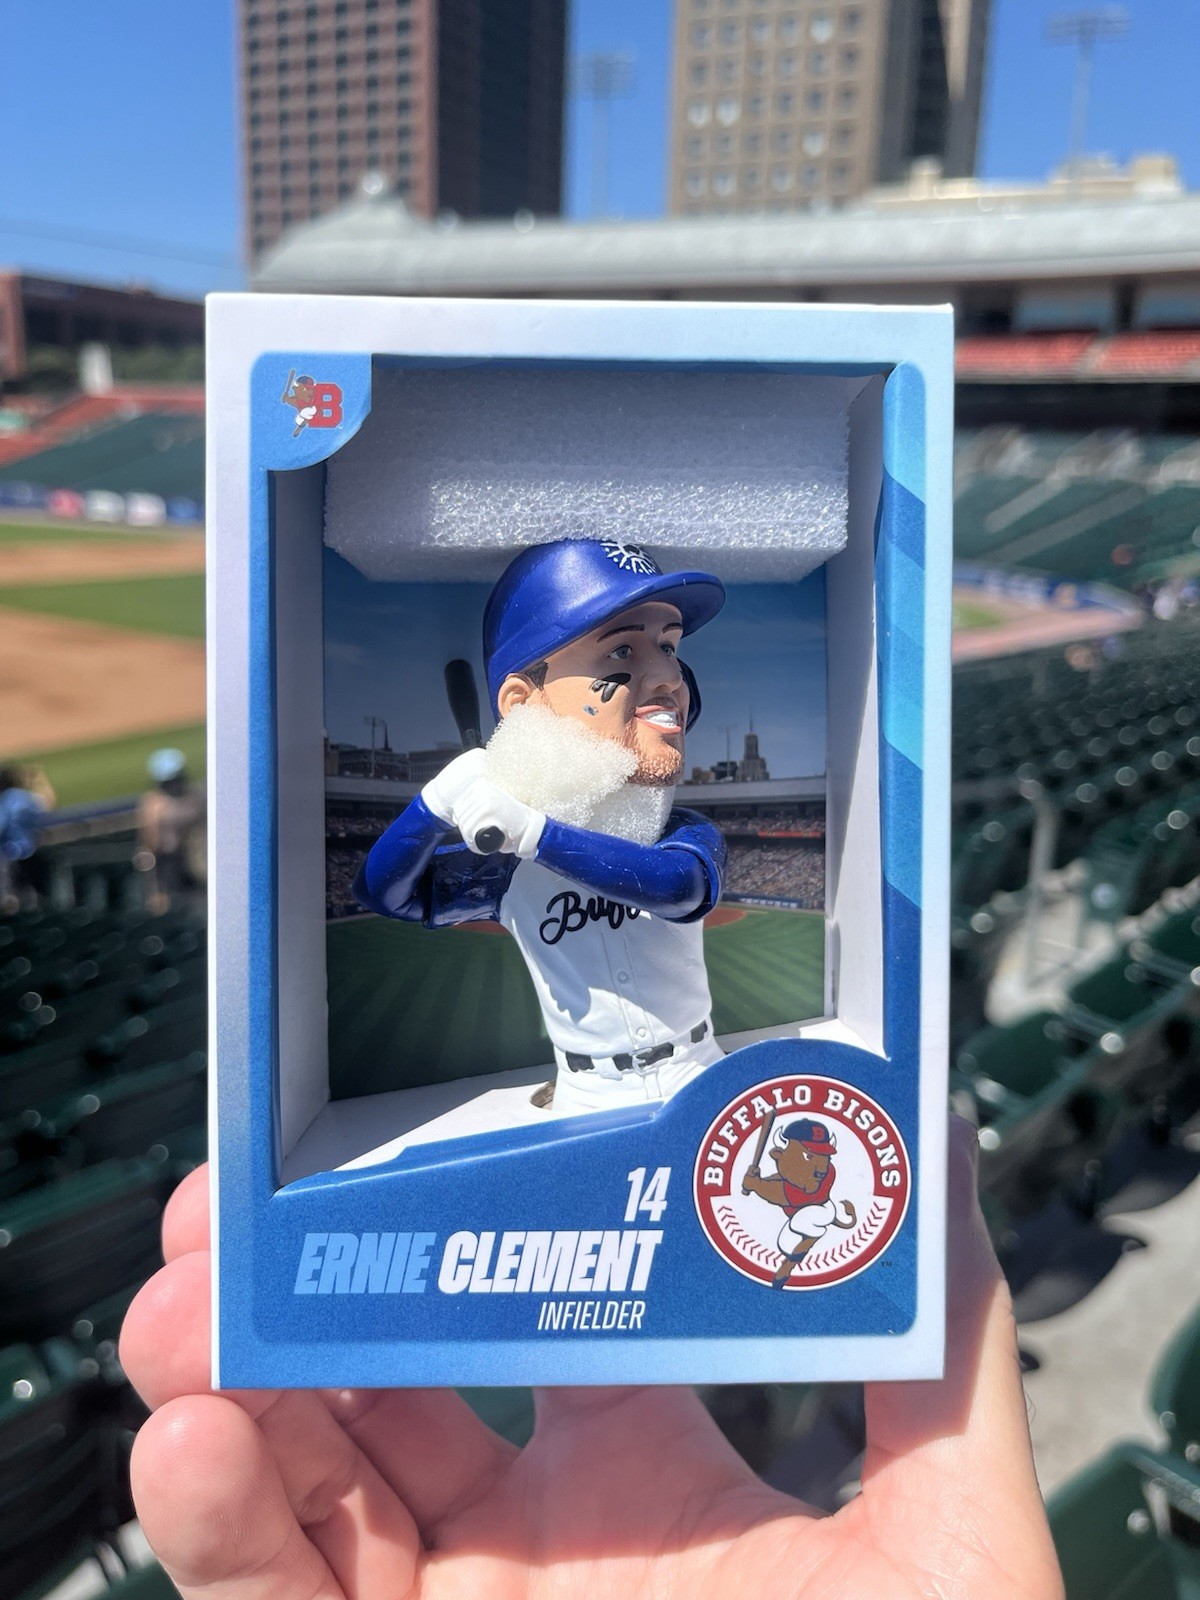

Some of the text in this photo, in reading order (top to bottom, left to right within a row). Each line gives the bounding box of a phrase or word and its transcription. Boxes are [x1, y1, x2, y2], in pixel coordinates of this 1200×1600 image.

[703, 1085, 901, 1188] BUFFALO BISONS
[623, 1167, 672, 1222] 14
[293, 1229, 664, 1295] ERNIE CLEMENT
[537, 1300, 646, 1330] INFIELDER
